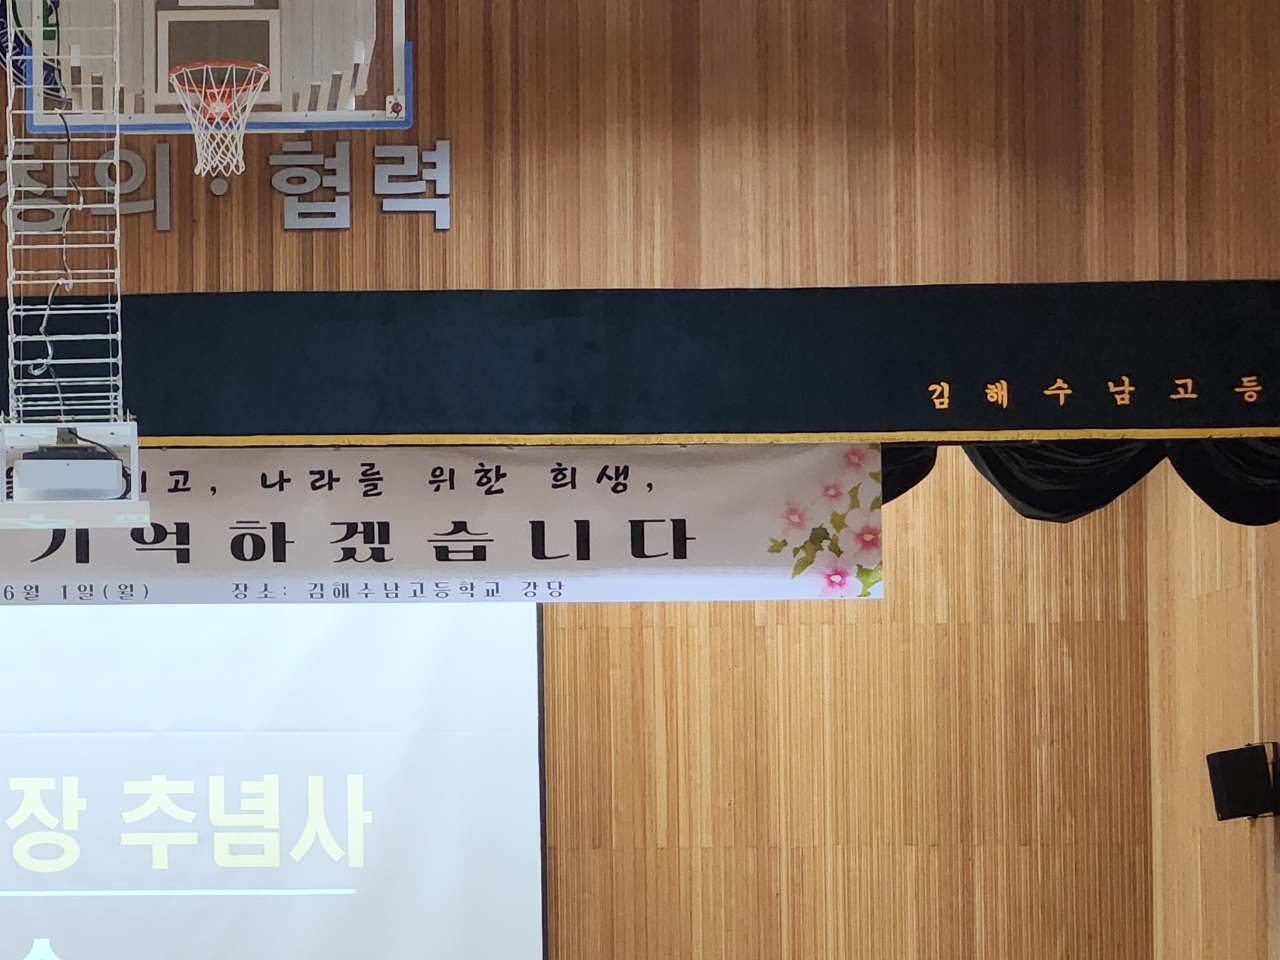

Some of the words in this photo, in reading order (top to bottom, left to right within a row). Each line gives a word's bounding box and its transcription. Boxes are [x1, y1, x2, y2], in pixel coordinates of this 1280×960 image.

[269, 140, 450, 230] 협력
[927, 375, 1263, 409] 김해수남고등
[260, 462, 384, 498] 나라를
[428, 462, 508, 496] 위한
[550, 462, 654, 494] 희생,
[30, 518, 696, 565] 기억하겠습니다
[3, 584, 40, 601] 6월
[61, 583, 150, 601] 1일(월)
[231, 582, 287, 600] 장소:
[307, 581, 502, 600] 김해수남고등학교
[521, 580, 565, 598] 강당
[120, 774, 372, 870] 추념사
